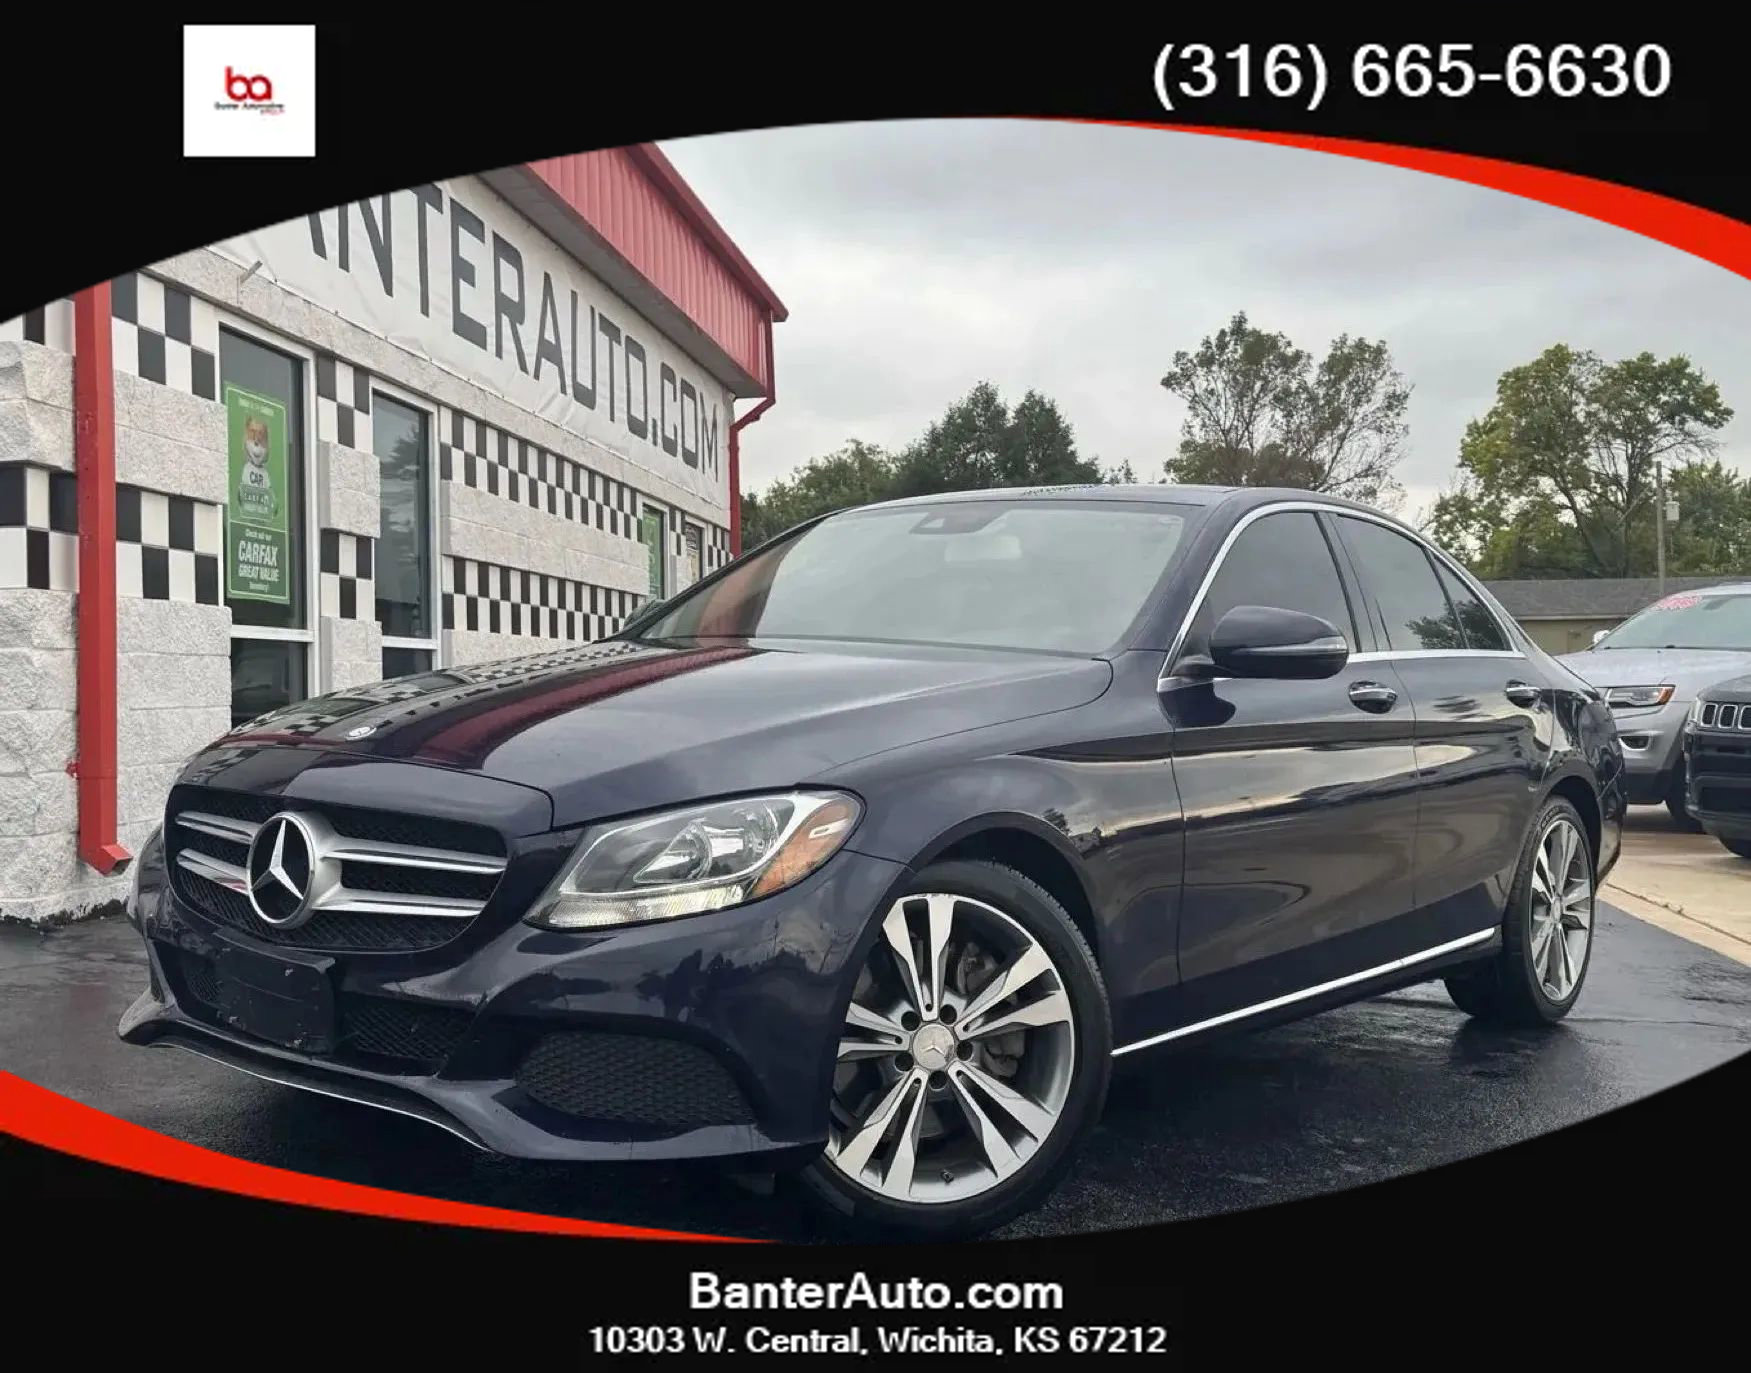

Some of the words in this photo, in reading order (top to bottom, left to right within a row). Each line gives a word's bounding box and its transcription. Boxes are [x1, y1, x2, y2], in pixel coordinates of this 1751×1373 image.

[238, 540, 278, 567] CARFAX
[238, 563, 259, 580] GREAT
[259, 567, 280, 582] VALUE
